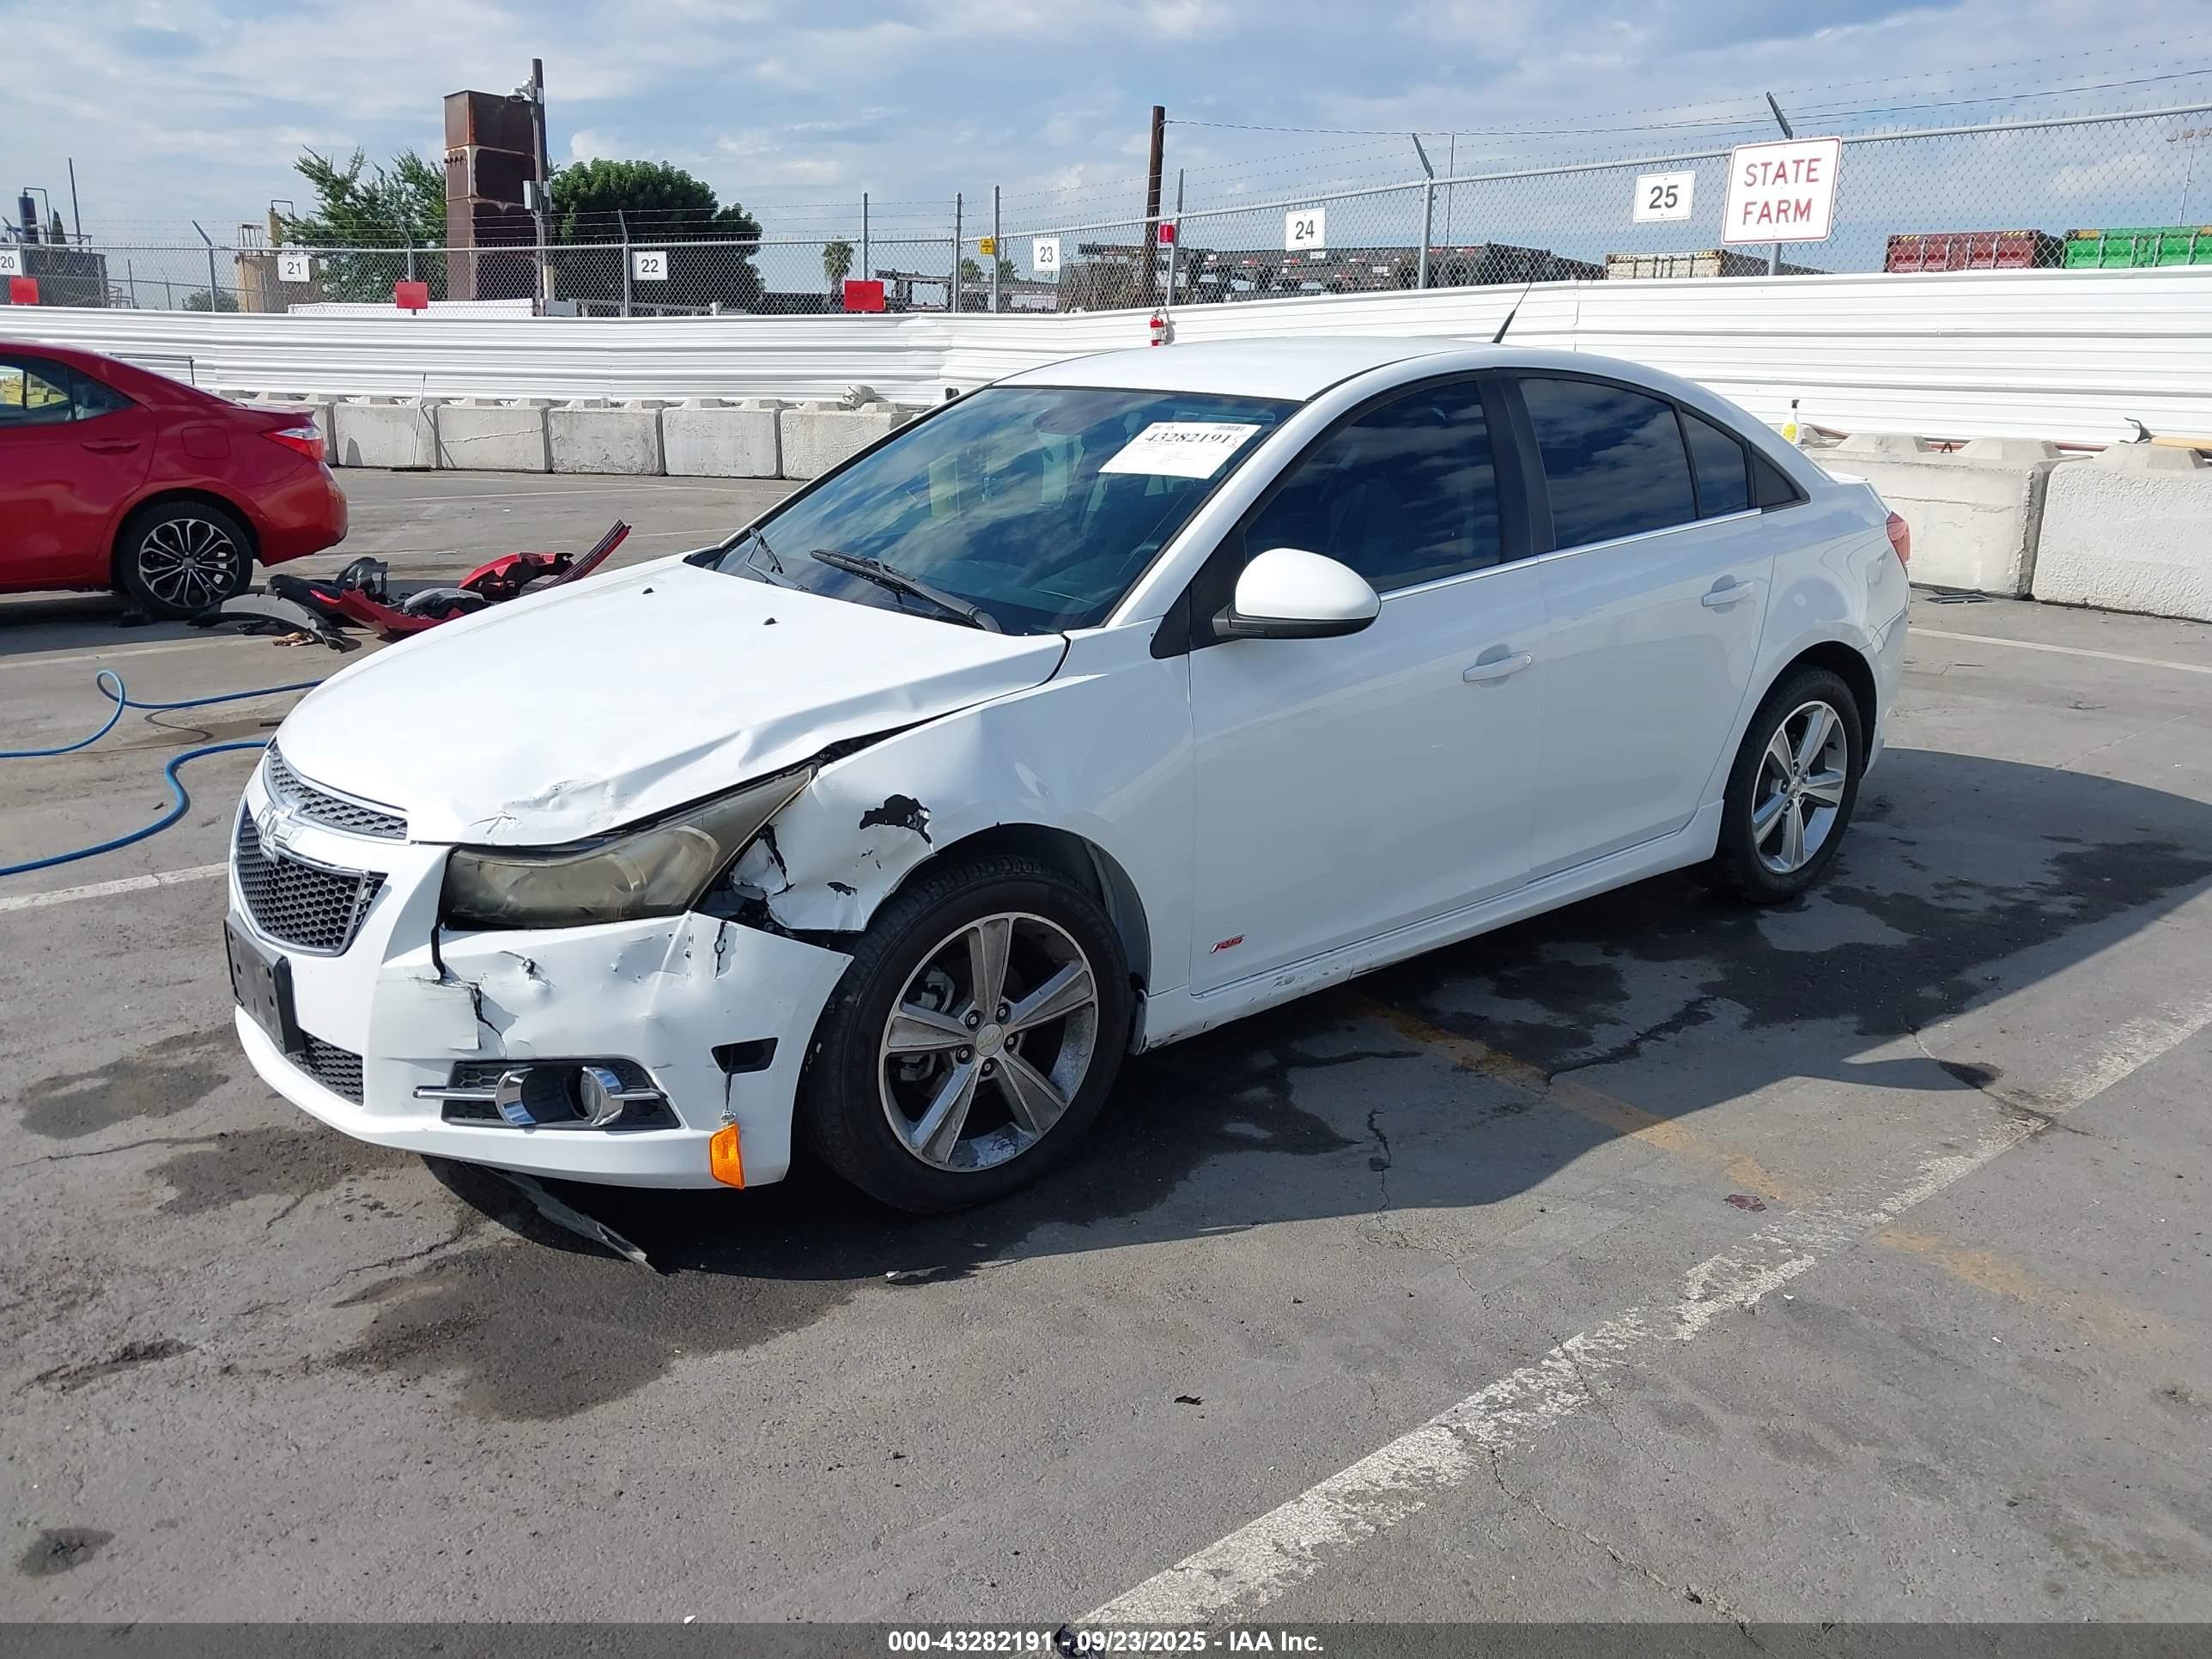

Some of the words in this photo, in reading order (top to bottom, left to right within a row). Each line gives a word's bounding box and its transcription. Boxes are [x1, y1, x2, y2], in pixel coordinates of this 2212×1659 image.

[1743, 157, 1822, 187] STATE
[1649, 185, 1679, 209] 25
[1741, 198, 1813, 226] FARM
[1295, 220, 1315, 240] 24
[0, 255, 15, 269] 20
[1039, 246, 1054, 263] 23
[287, 261, 301, 275] 21
[641, 258, 659, 273] 22
[1145, 432, 1233, 444] 43282191
